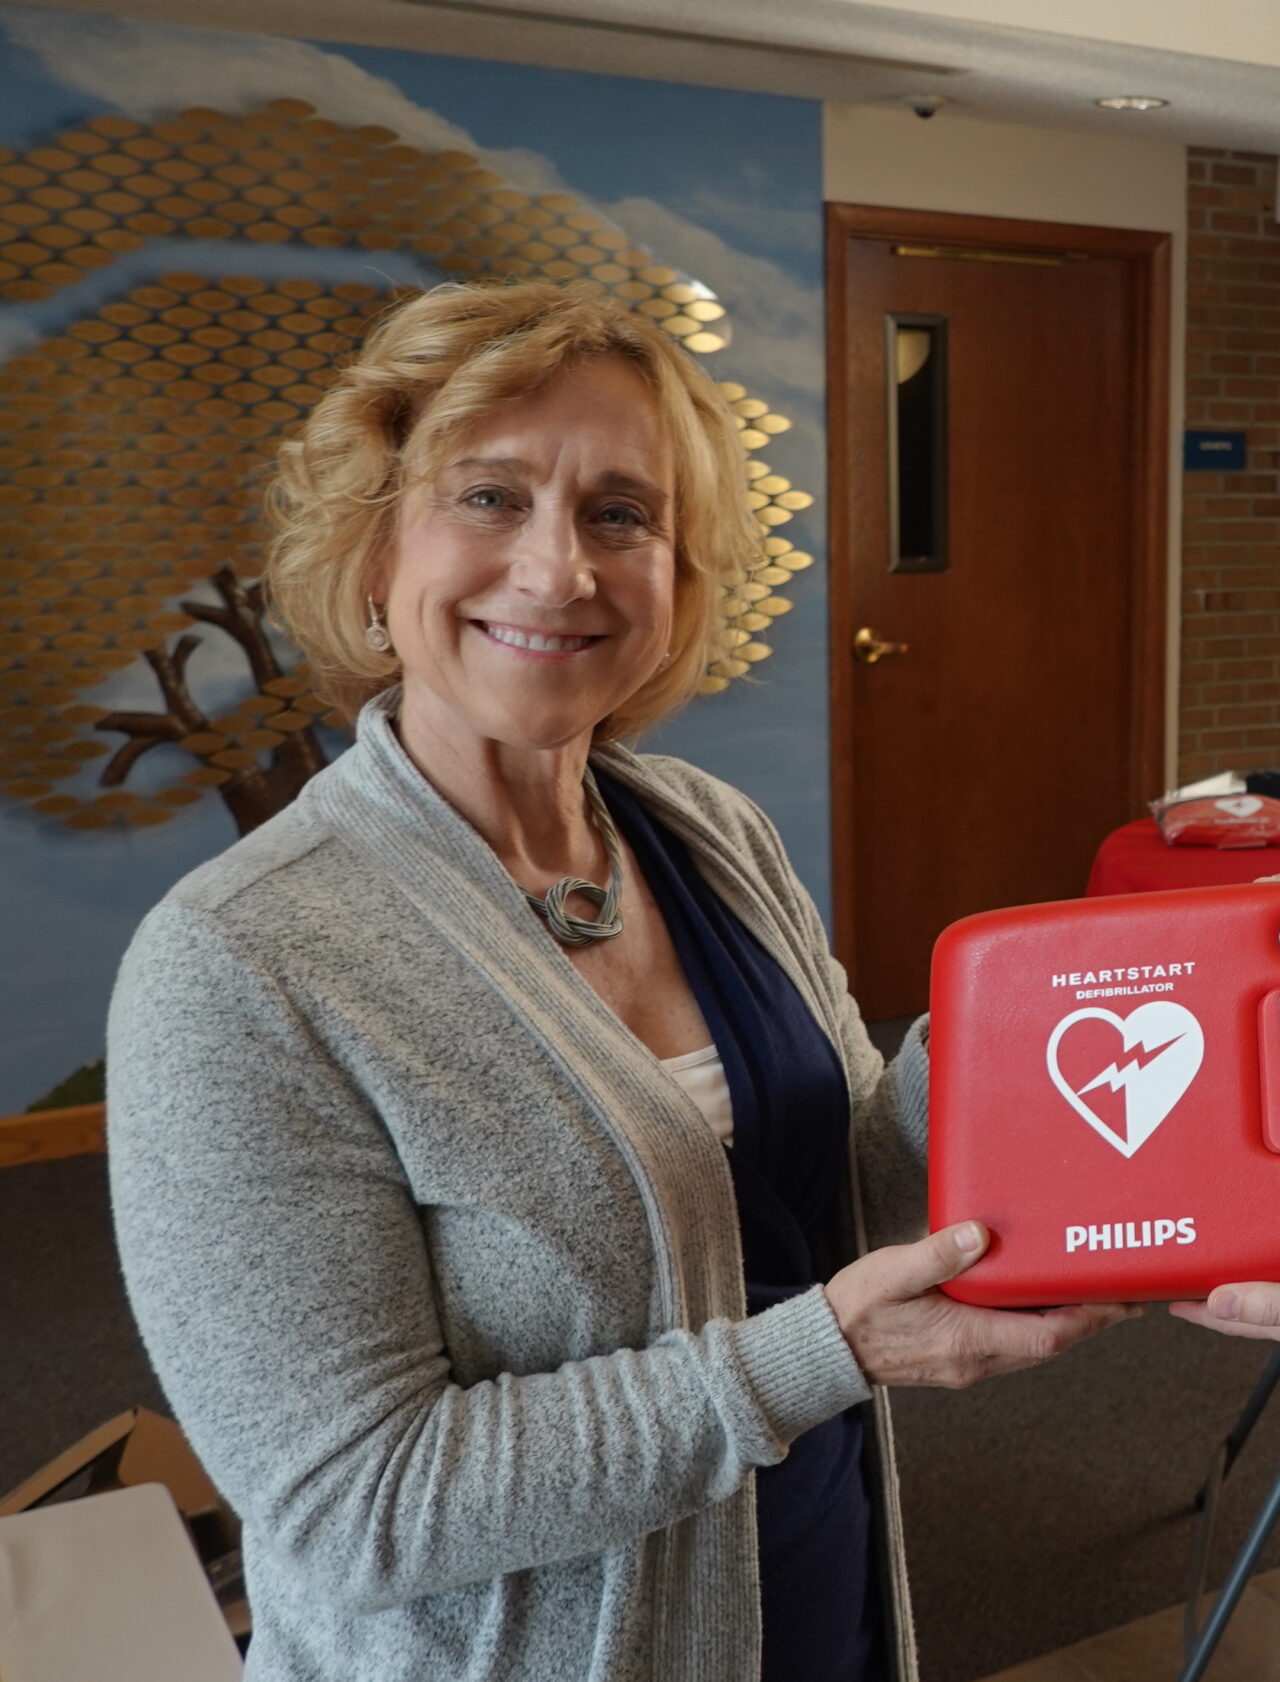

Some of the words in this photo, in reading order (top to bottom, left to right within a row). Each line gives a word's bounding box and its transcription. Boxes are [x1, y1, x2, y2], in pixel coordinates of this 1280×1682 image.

[1052, 962, 1195, 988] HEARTSTART
[1076, 982, 1174, 1000] DEFIBRILLATOR
[1066, 1217, 1197, 1253] PHILIPS
